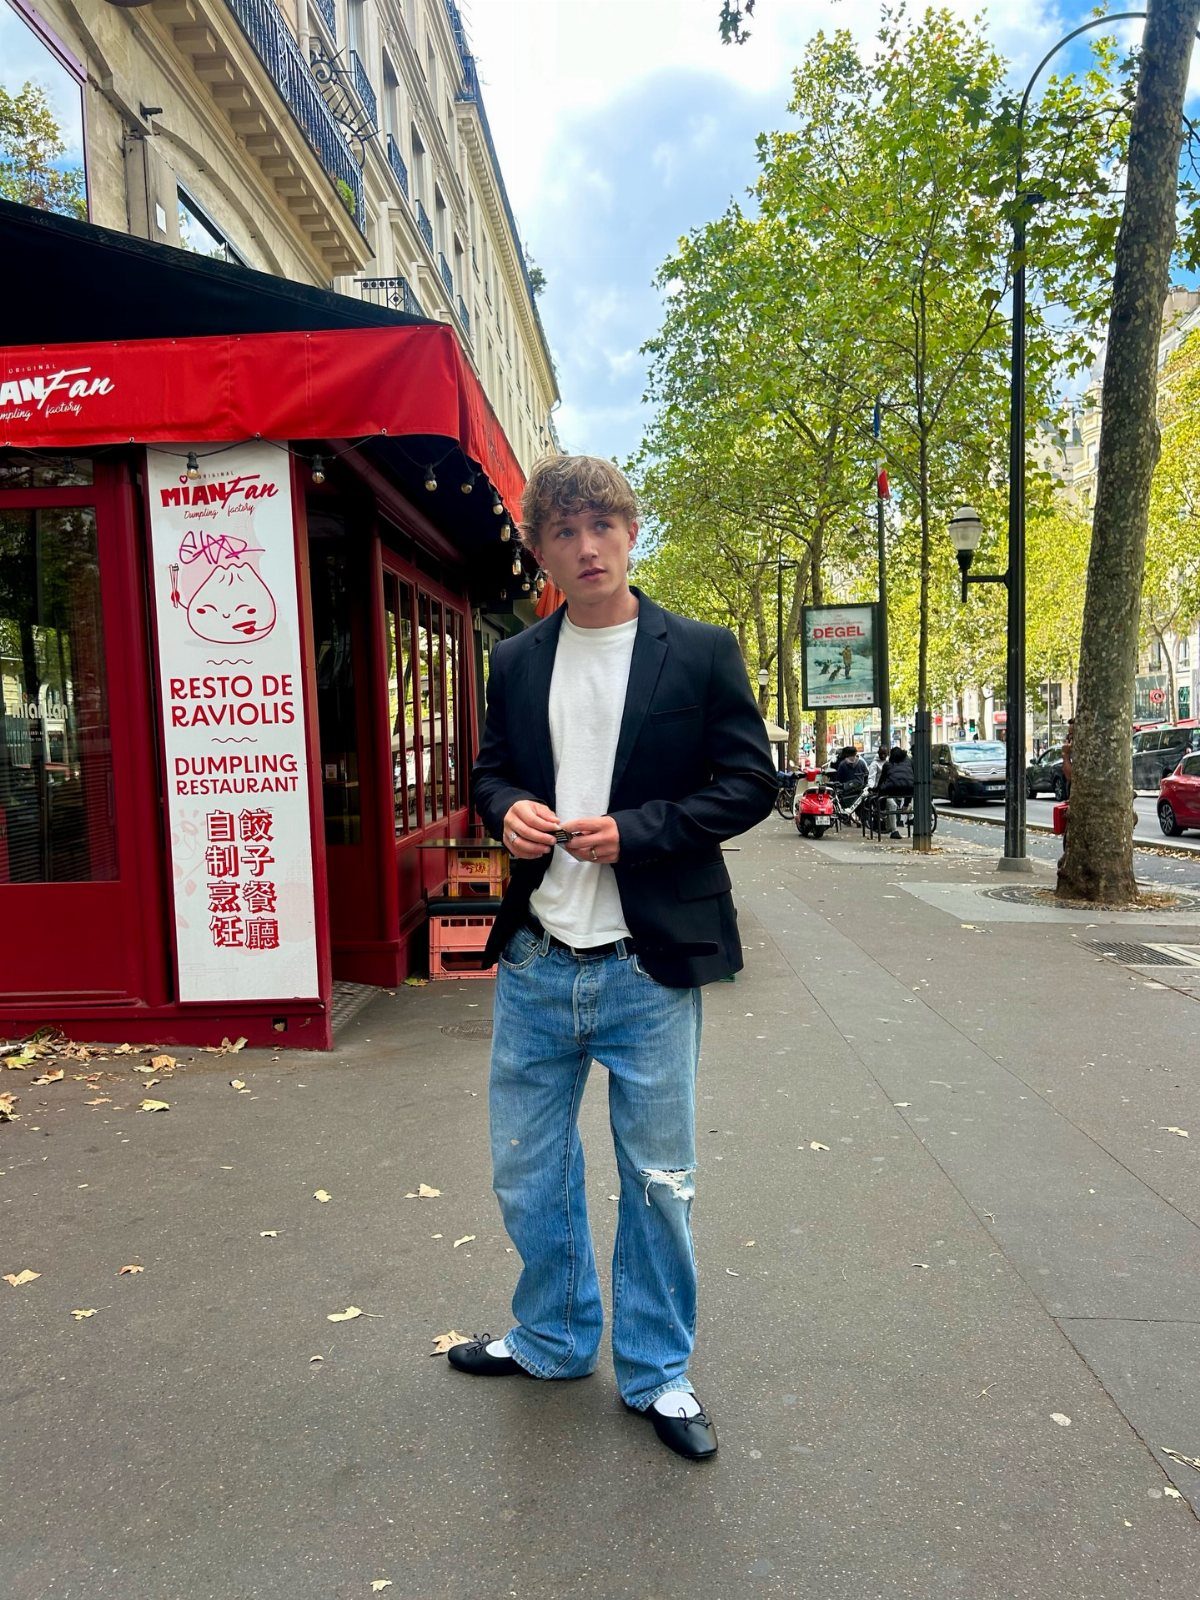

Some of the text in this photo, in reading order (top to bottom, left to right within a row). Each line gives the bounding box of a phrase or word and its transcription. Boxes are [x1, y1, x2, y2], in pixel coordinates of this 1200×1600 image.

[9, 363, 57, 374] ORIGINAL
[45, 401, 83, 418] factory
[184, 503, 256, 521] Dumpling factory
[170, 674, 293, 700] RESTO DE
[171, 701, 295, 727] RAVIOLIS
[174, 753, 298, 776] DUMPLING
[176, 776, 299, 796] RESTAURANT
